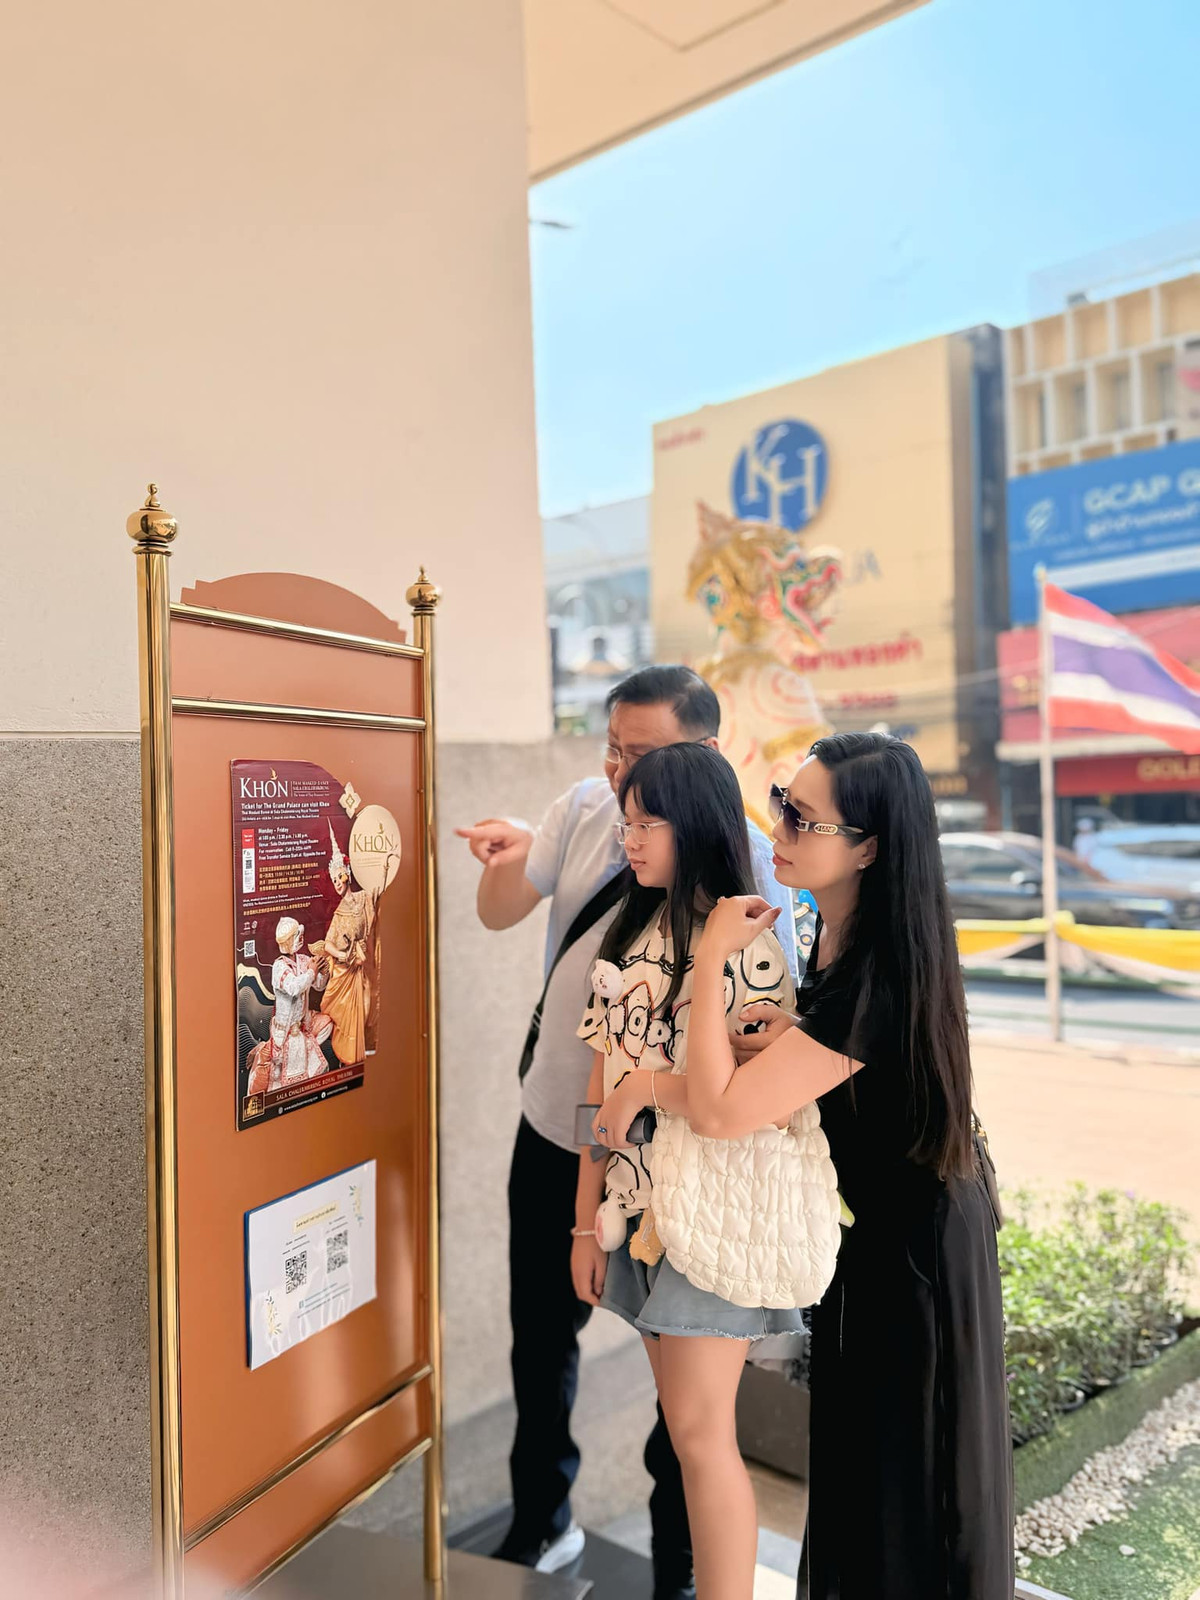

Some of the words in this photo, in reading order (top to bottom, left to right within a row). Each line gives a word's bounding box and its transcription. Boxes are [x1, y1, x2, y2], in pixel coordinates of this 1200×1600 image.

[1084, 475, 1171, 514] GCAP
[240, 777, 288, 798] KHON
[353, 833, 394, 852] KHON
[276, 1092, 288, 1101] SALA
